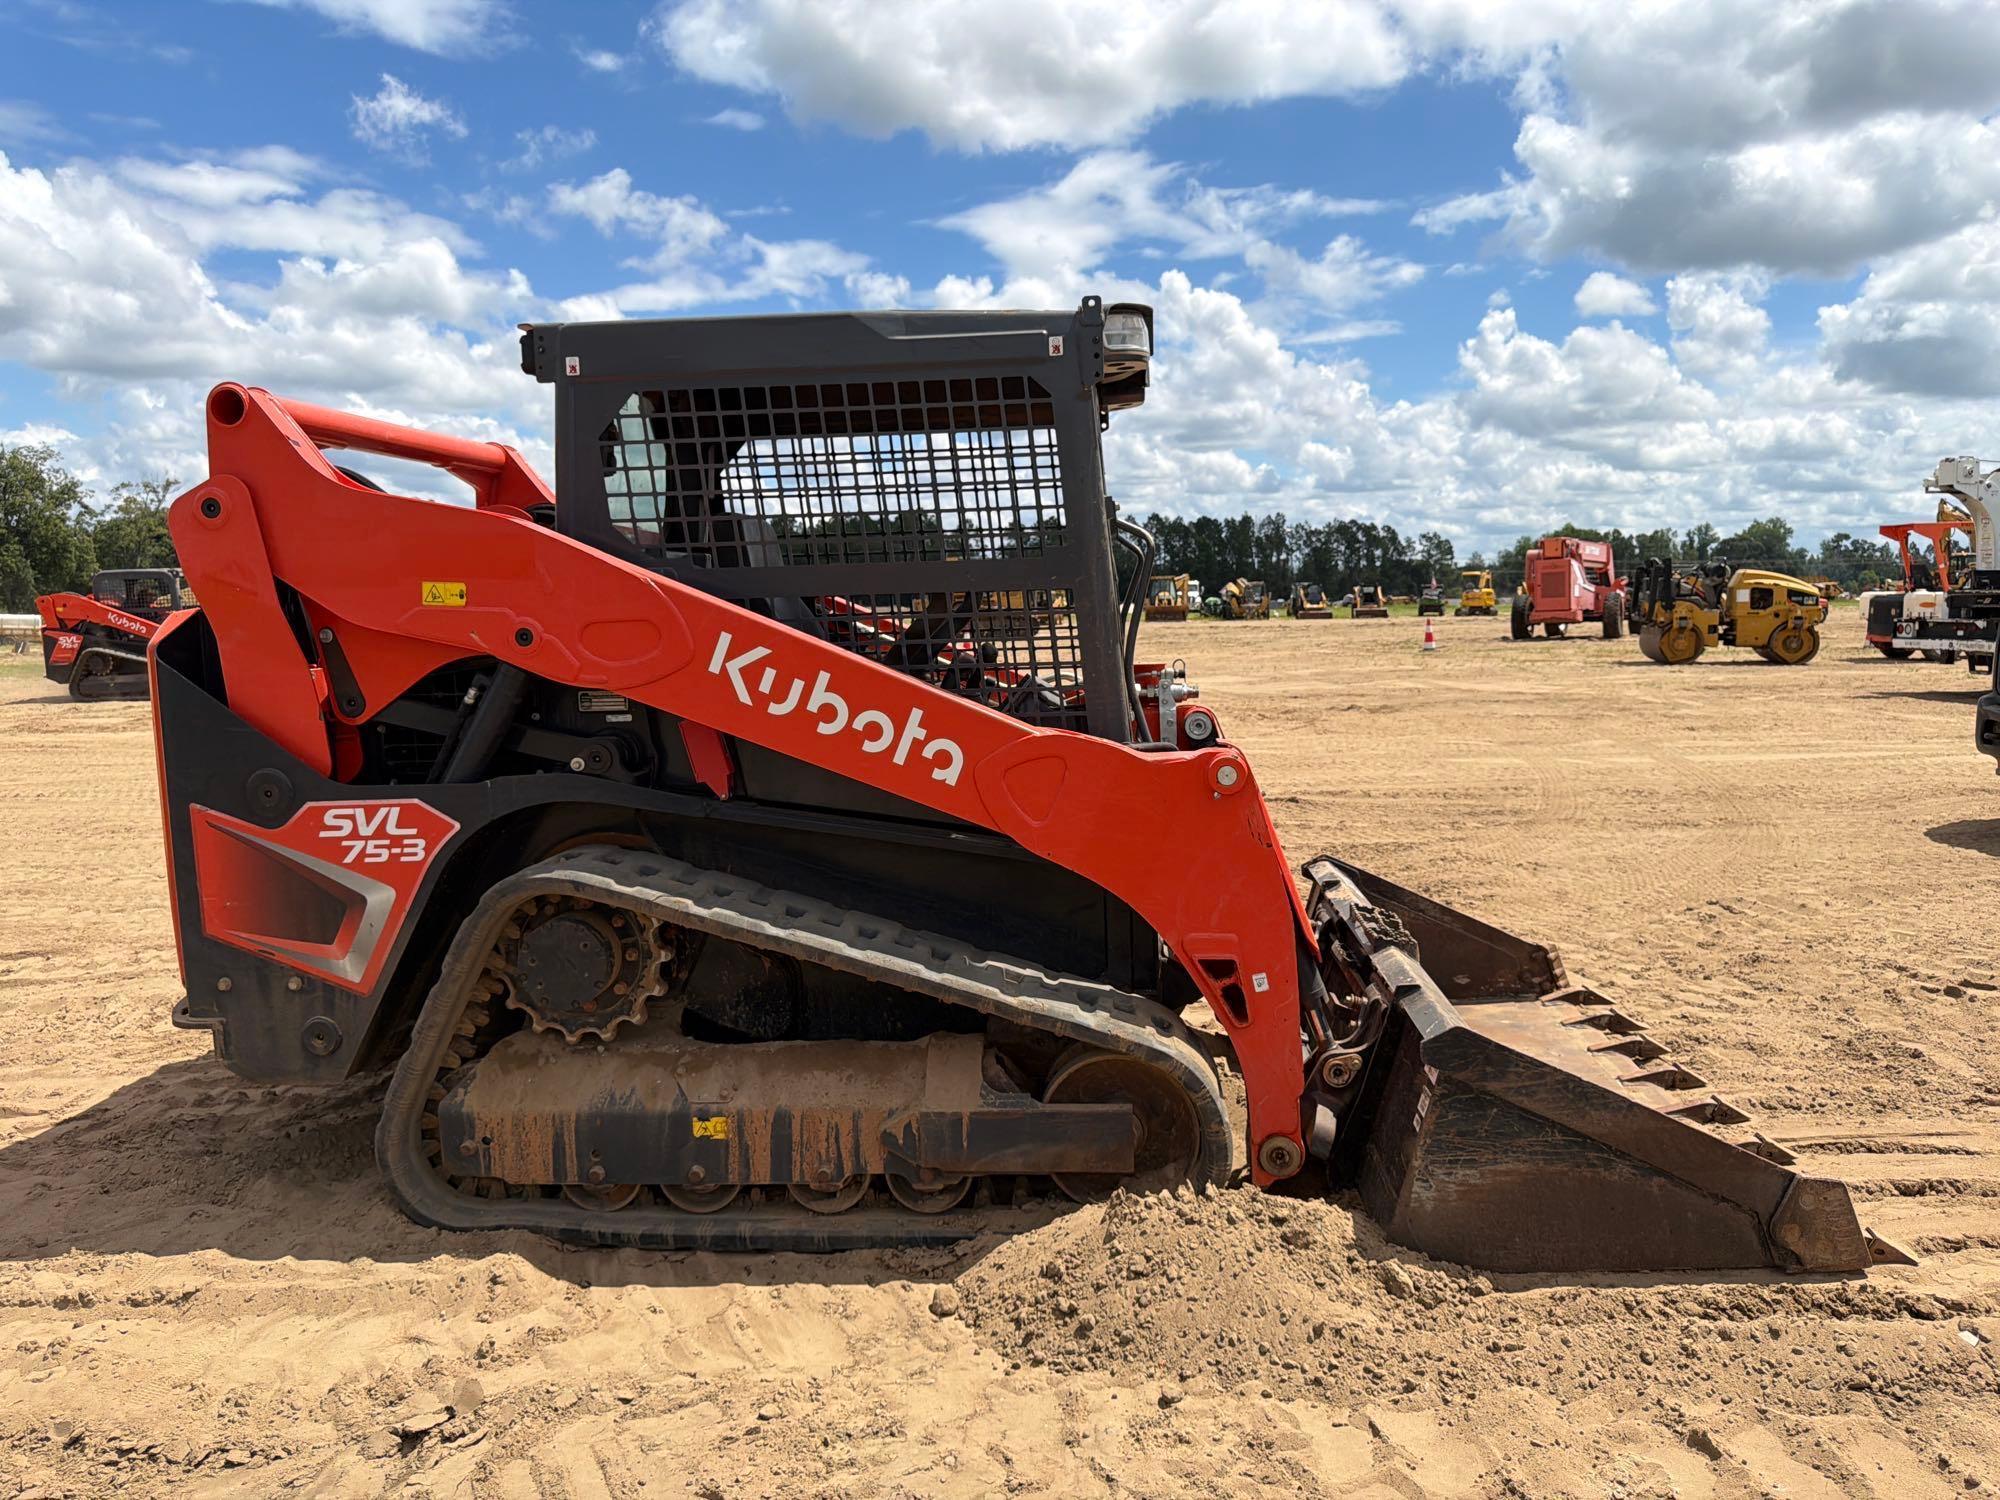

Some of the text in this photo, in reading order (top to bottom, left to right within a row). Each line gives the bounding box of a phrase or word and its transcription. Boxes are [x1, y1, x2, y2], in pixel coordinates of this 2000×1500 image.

[1803, 596, 1817, 605] CAT
[107, 612, 147, 634] Kubota
[708, 631, 964, 787] Kubota
[318, 807, 418, 838] SVL
[341, 838, 426, 864] 75-3
